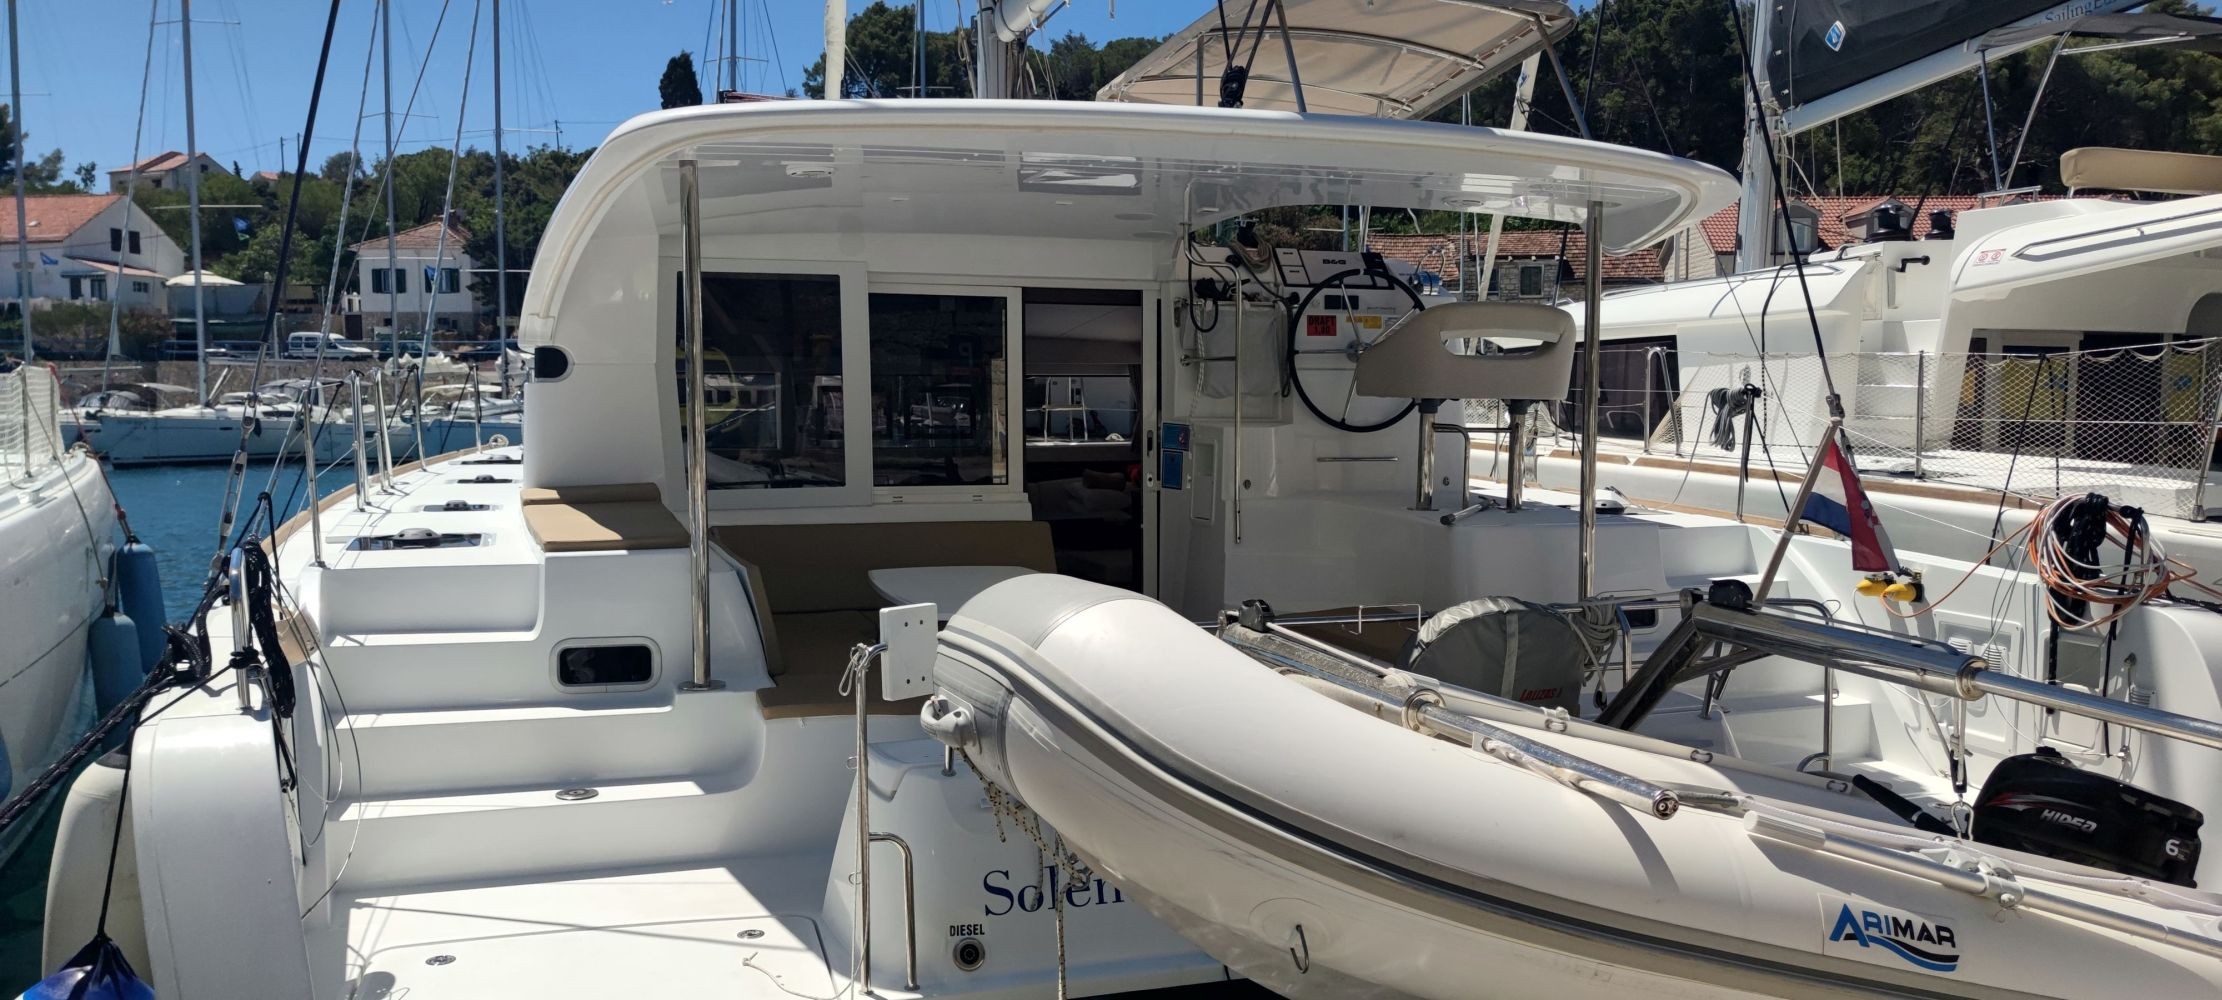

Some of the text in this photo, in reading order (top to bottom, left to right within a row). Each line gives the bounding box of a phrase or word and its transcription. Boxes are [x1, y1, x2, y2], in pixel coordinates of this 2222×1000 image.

[1309, 316, 1336, 326] DRAFT
[2040, 809, 2098, 834] HIDEA
[2165, 838, 2180, 856] 6
[949, 923, 986, 937] DIESEL
[1829, 903, 1956, 948] ARIMAR
